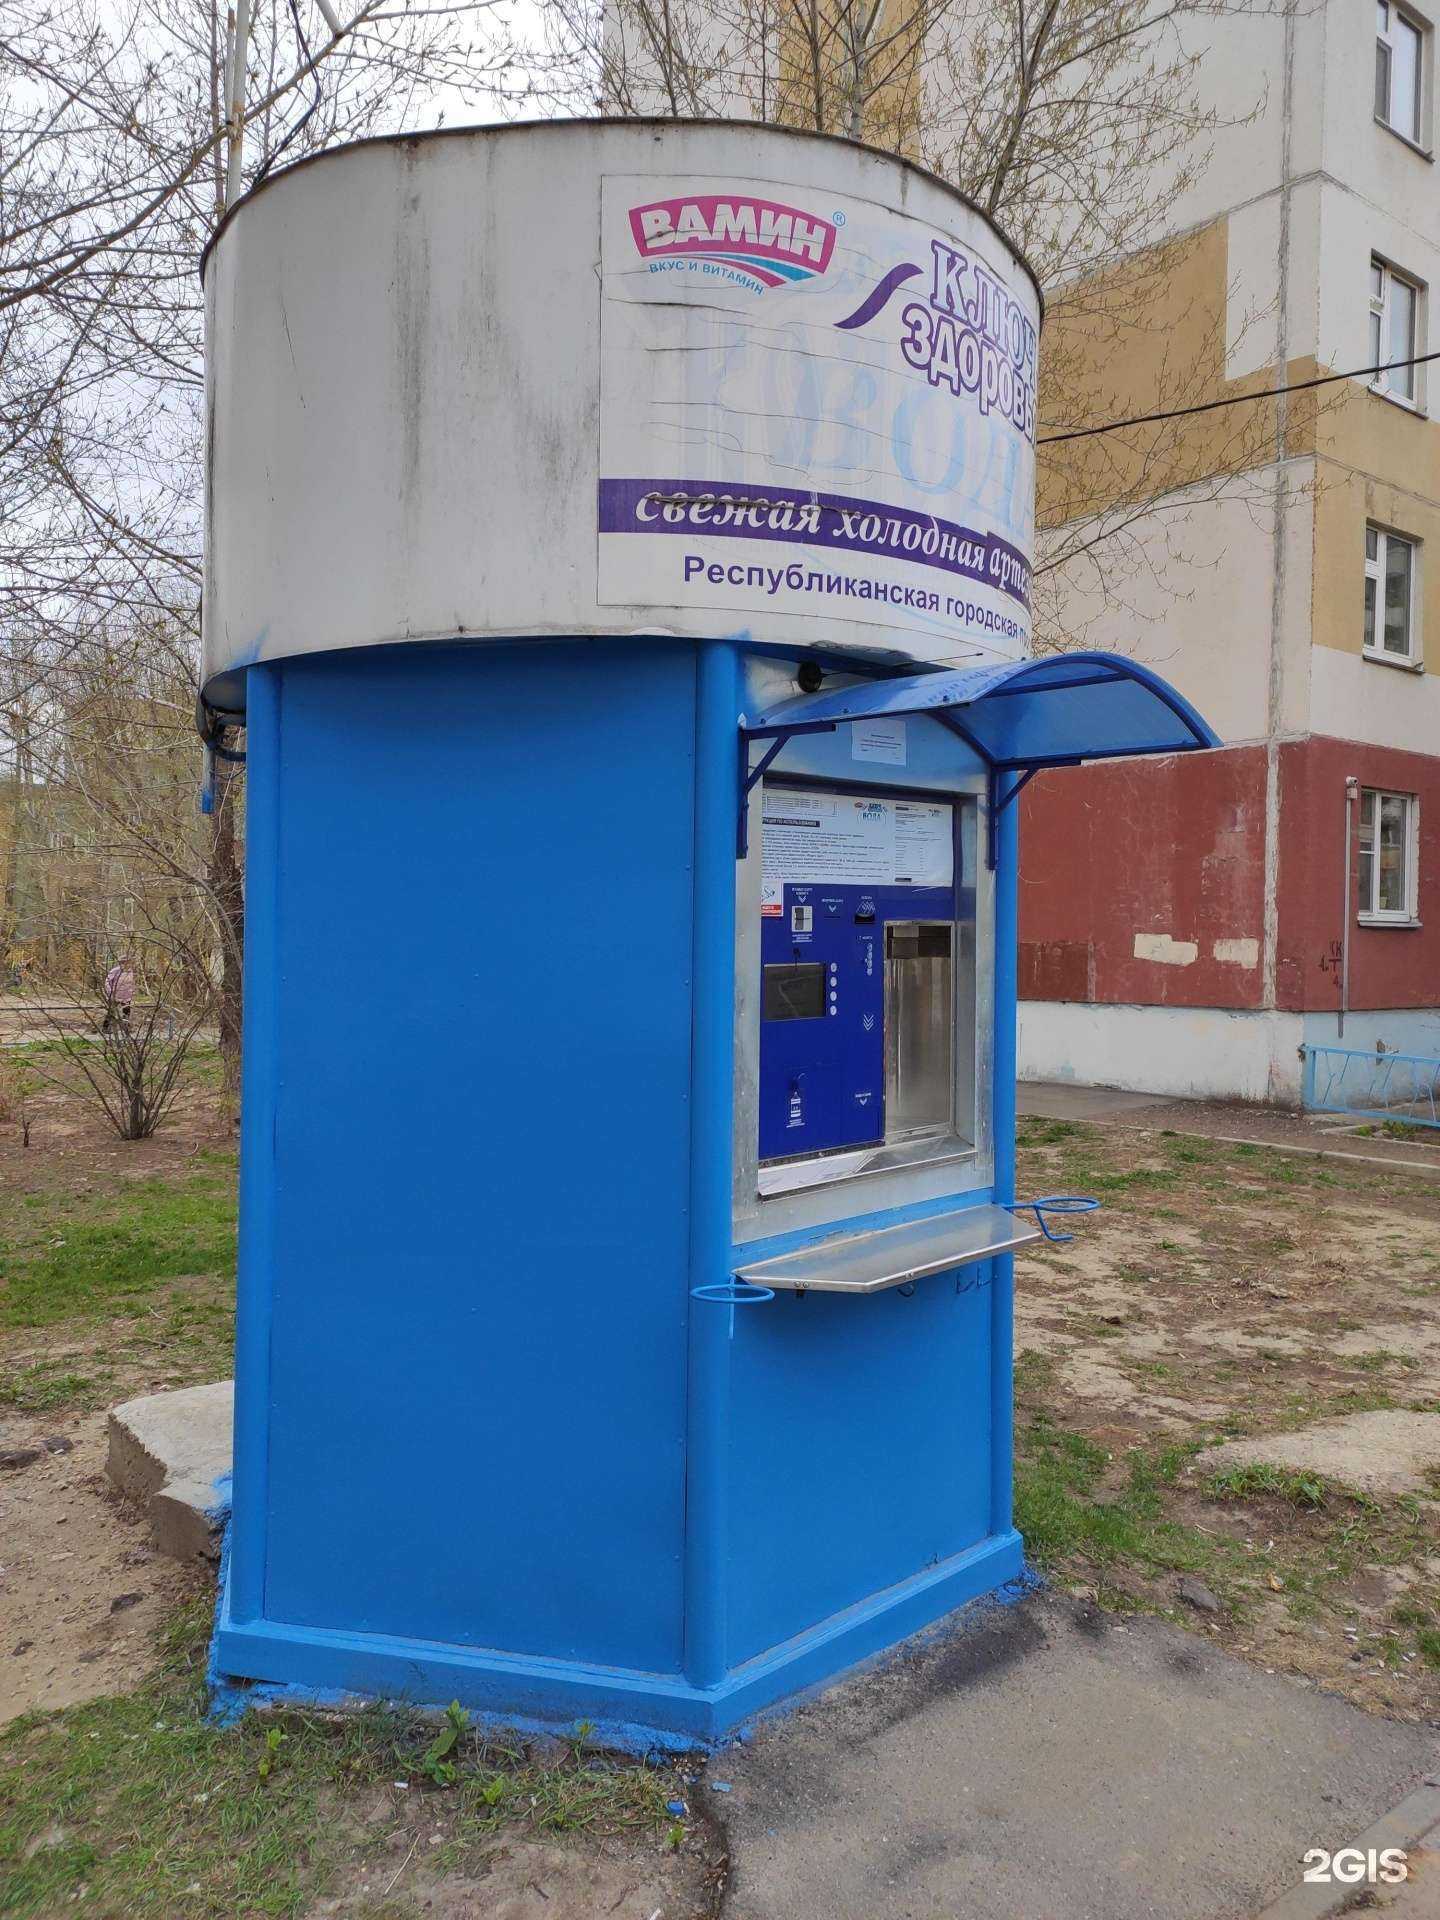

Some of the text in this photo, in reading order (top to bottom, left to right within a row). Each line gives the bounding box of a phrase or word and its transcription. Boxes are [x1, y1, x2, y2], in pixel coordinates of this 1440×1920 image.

[640, 203, 827, 263] ВАМИН
[650, 260, 765, 296] ВКУС И ВИТАМИН
[635, 491, 822, 535] свежая
[832, 509, 986, 572] холодная
[684, 555, 939, 612] Республиканская
[946, 597, 1018, 639] городская
